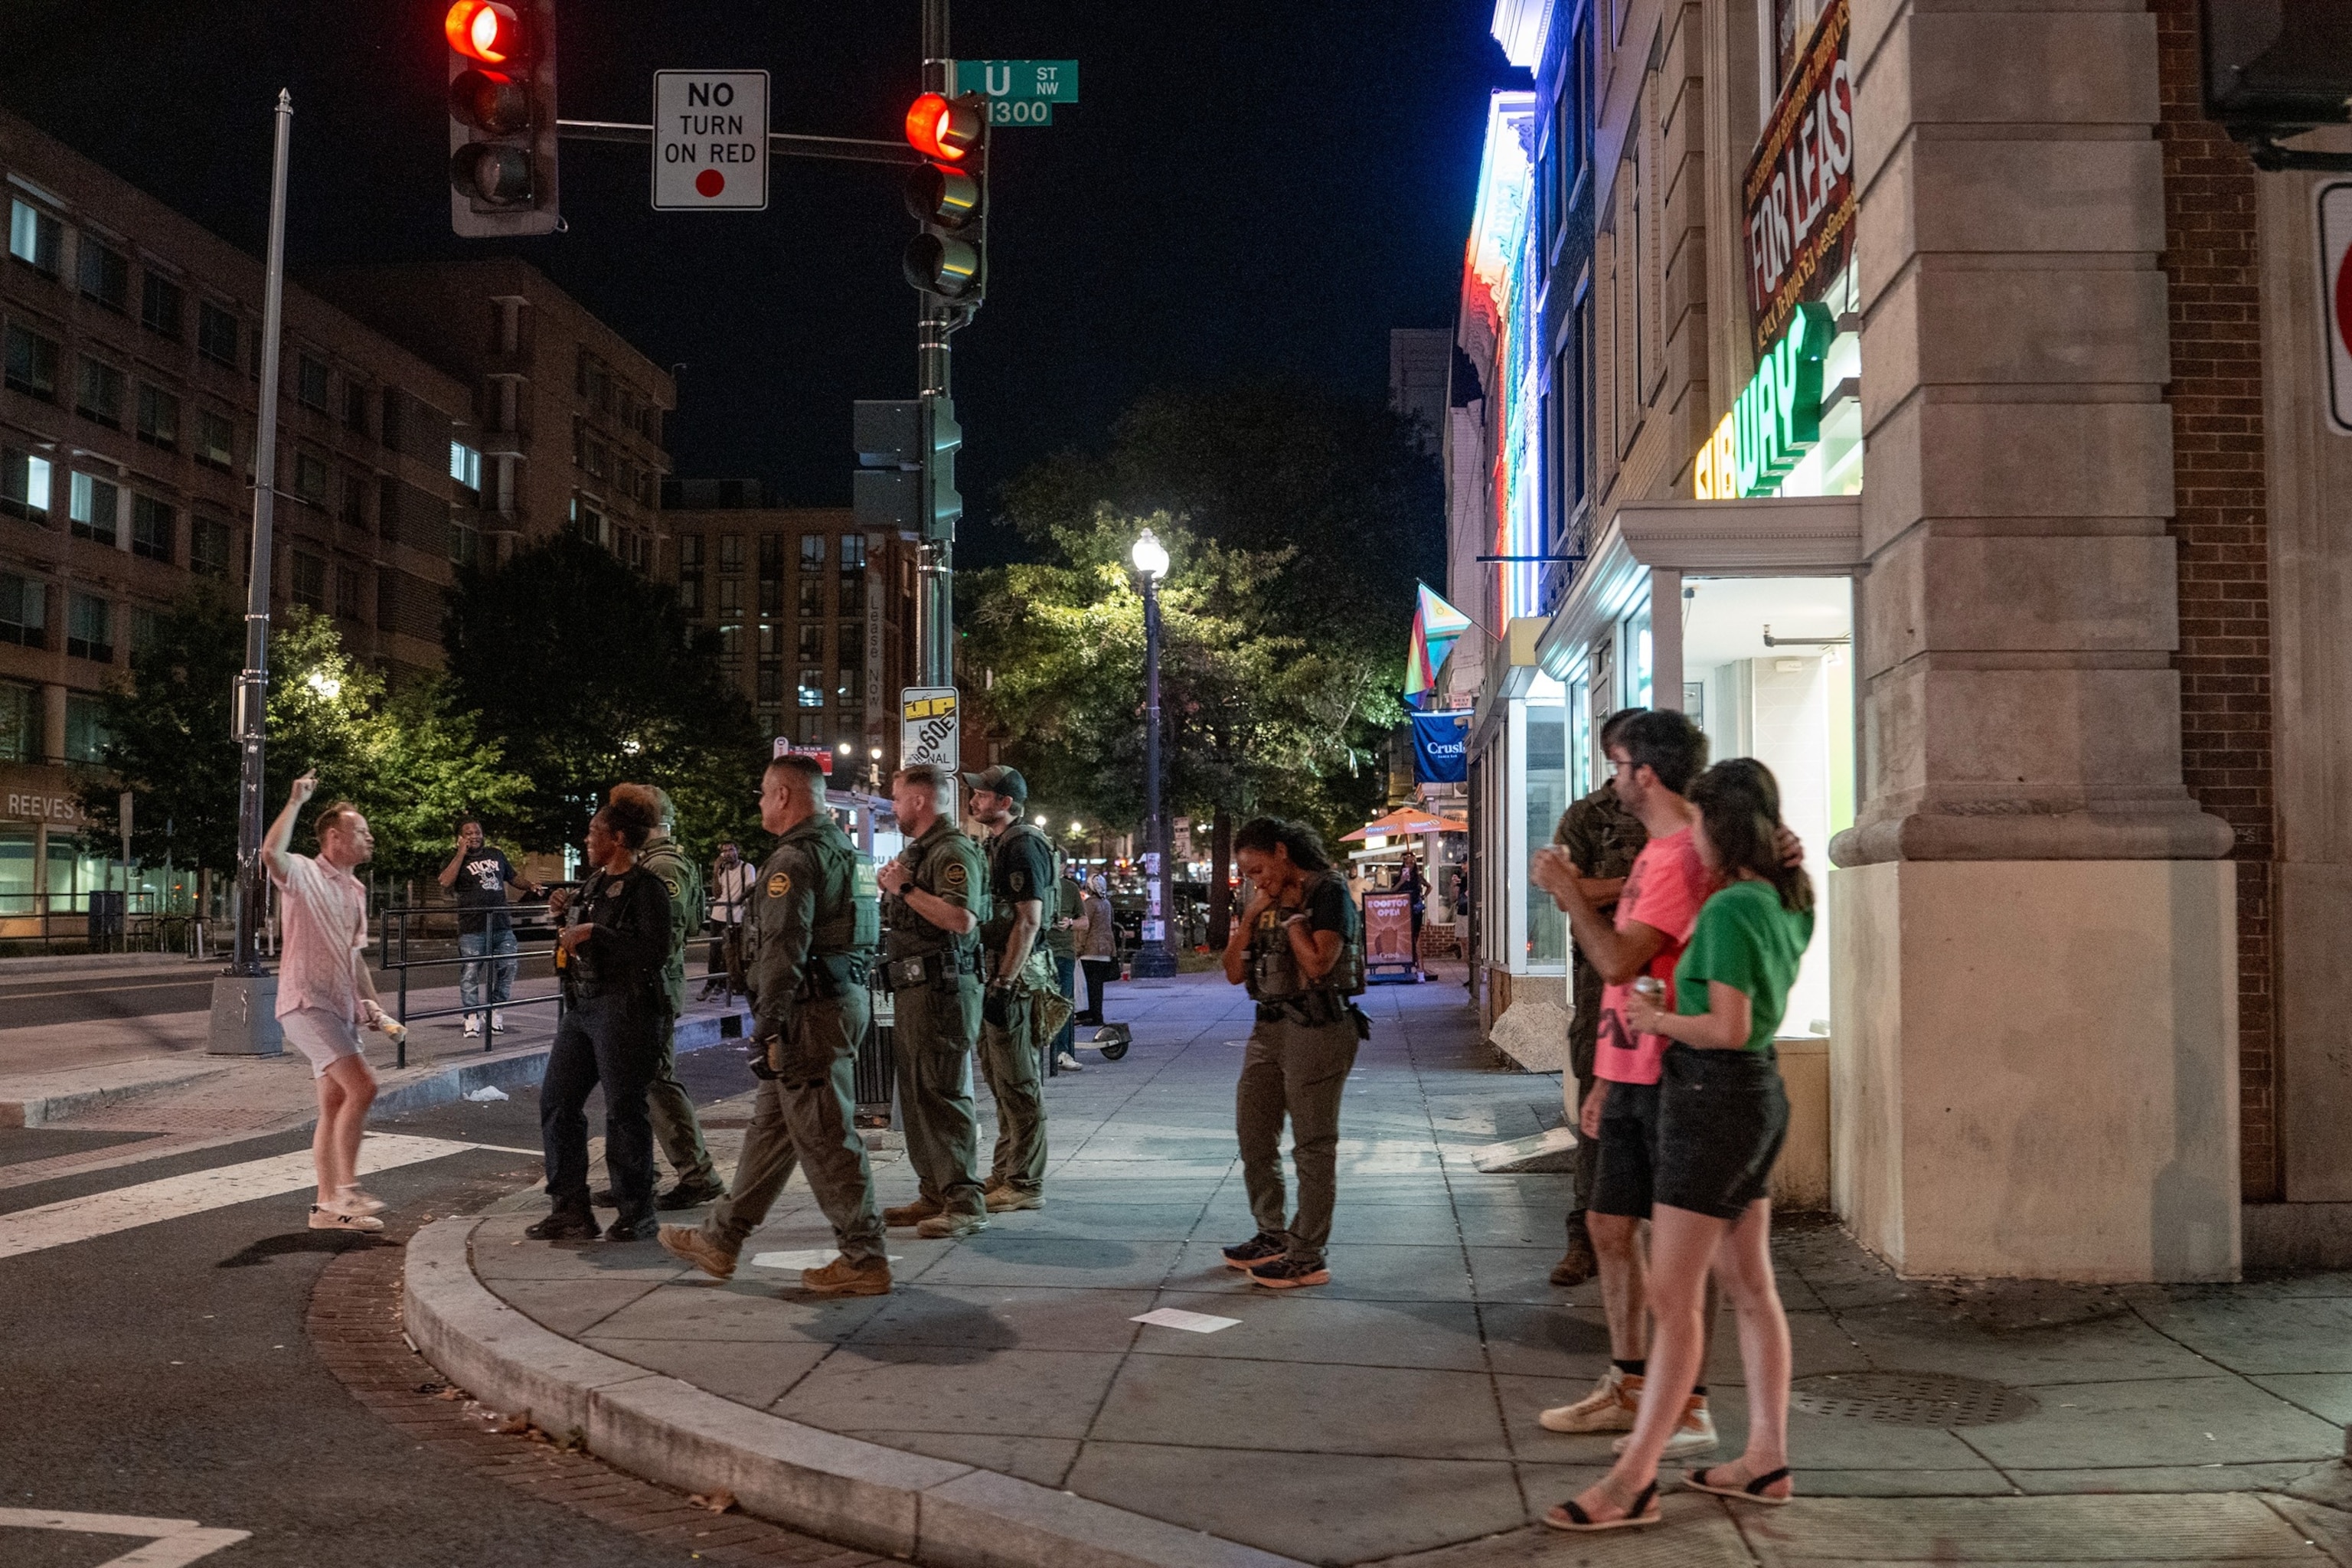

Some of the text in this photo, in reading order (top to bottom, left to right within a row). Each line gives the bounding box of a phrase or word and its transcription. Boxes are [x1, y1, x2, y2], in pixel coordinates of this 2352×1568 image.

[986, 66, 1058, 96] U ST
[1036, 82, 1059, 95] NW
[689, 83, 733, 106] NO
[988, 101, 1048, 122] 1300
[680, 116, 743, 135] TURN
[665, 143, 756, 163] ON RED
[1751, 172, 1792, 311] FOR
[1694, 303, 1806, 499] SUBWAY
[8, 793, 75, 819] REEVES
[466, 858, 500, 876] LUCKY
[1367, 899, 1409, 909] ROOFTOP
[1377, 908, 1400, 916] OPEN
